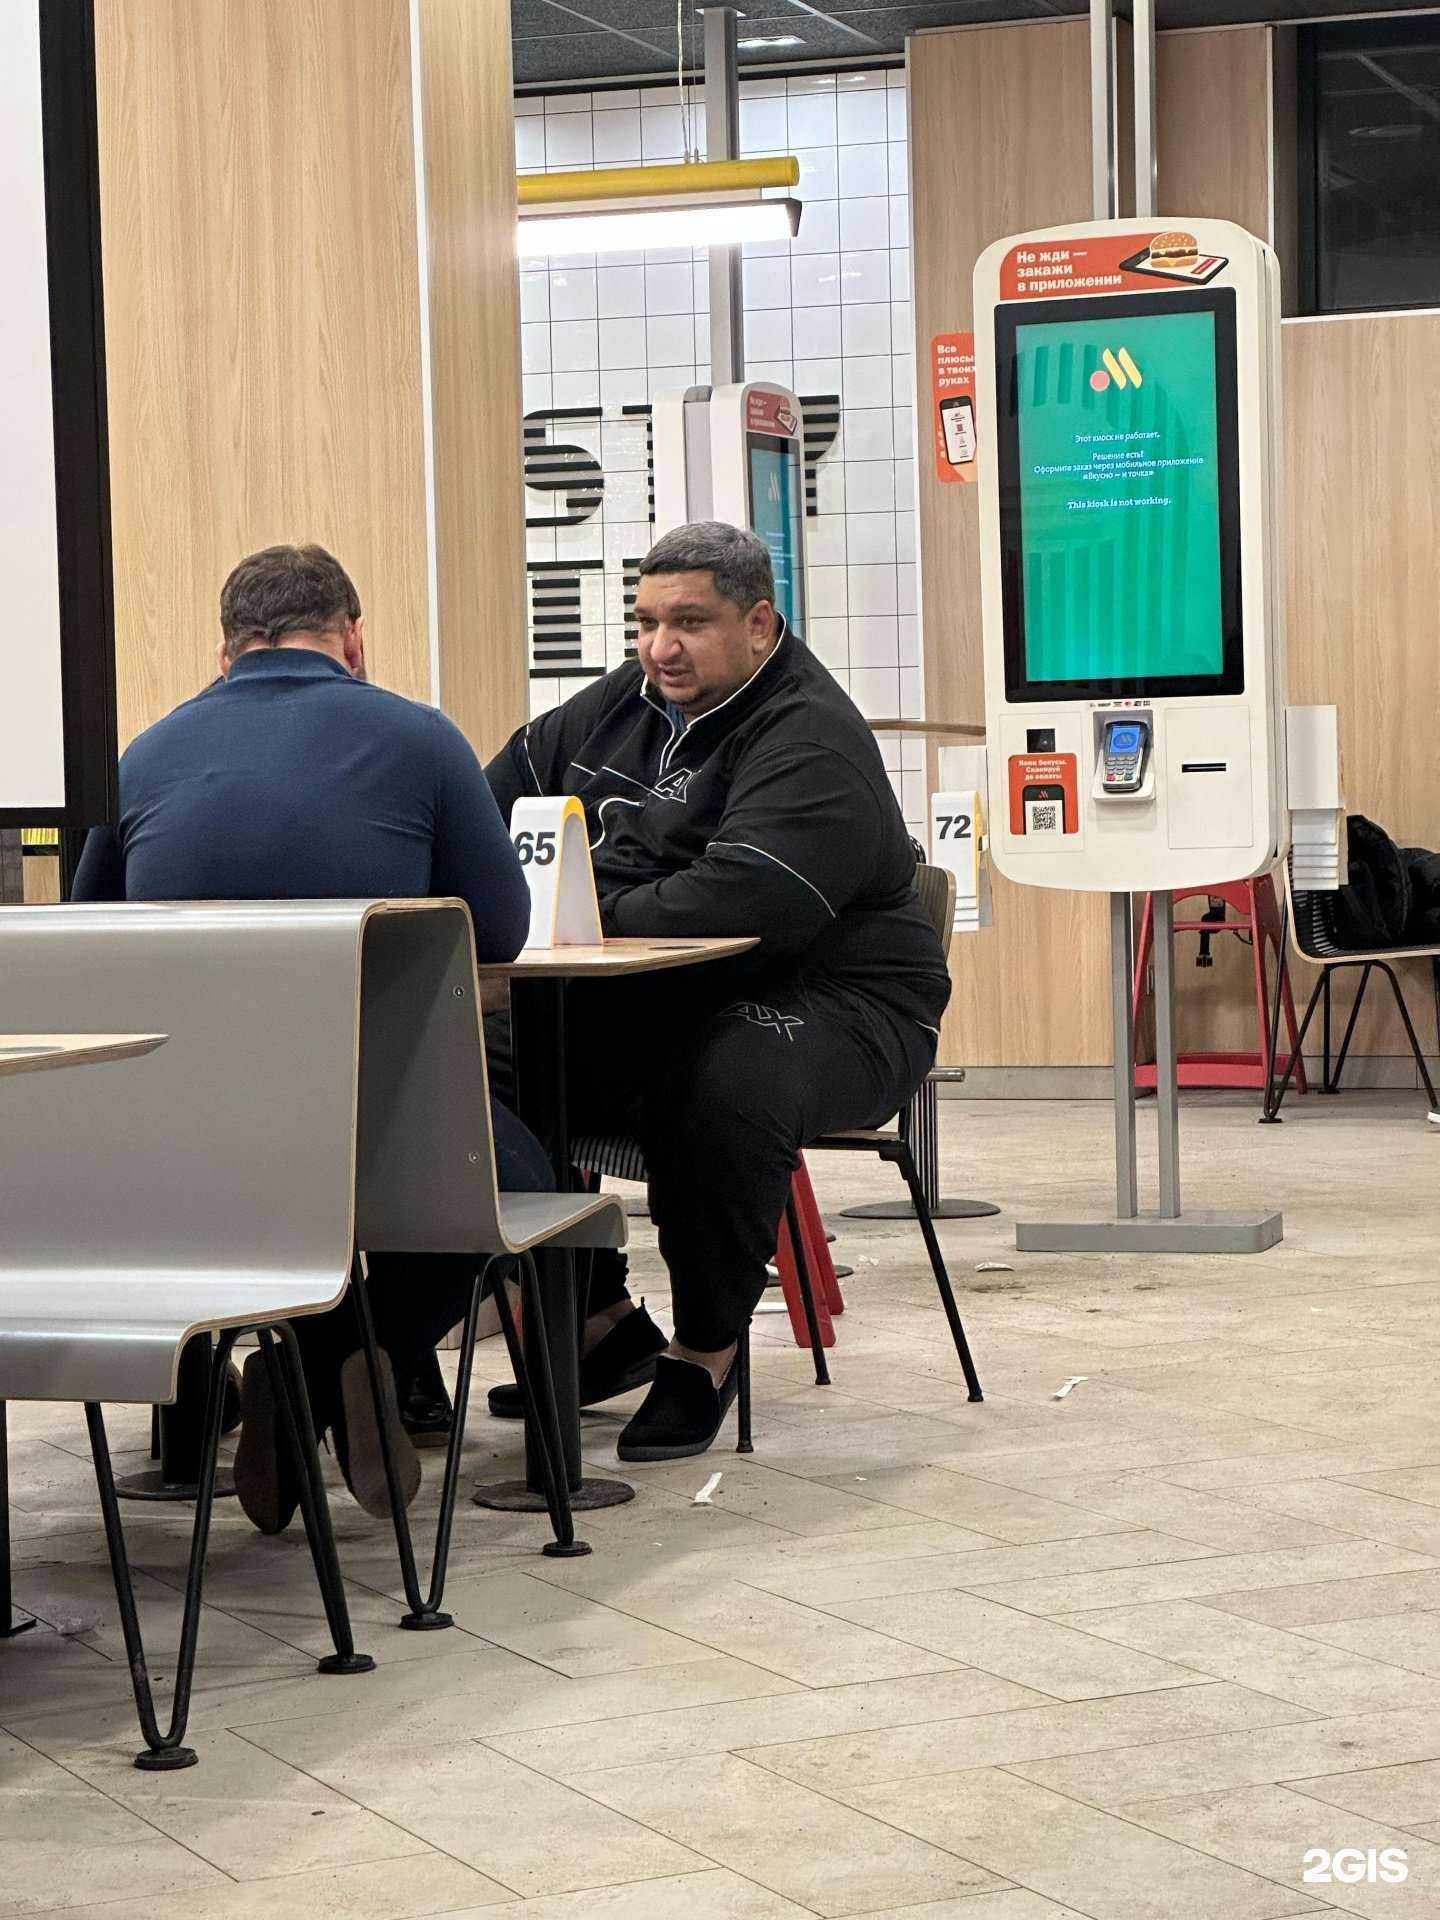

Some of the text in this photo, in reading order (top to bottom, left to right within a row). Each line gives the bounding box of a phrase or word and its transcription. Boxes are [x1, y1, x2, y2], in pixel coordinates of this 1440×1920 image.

[1017, 250, 1036, 263] Не
[1039, 249, 1070, 263] жди
[1017, 263, 1073, 278] закажи
[1018, 274, 1123, 293] в приложении
[937, 344, 957, 354] Все
[937, 355, 974, 365] плюсы
[938, 376, 970, 388] руках
[1092, 451, 1125, 461] Решение
[1115, 459, 1157, 470] мобильное
[1067, 500, 1086, 510] This
[1087, 499, 1110, 509] kiosk
[1110, 498, 1118, 507] is
[1118, 498, 1133, 507] not
[935, 814, 972, 840] 72
[514, 831, 556, 866] 65
